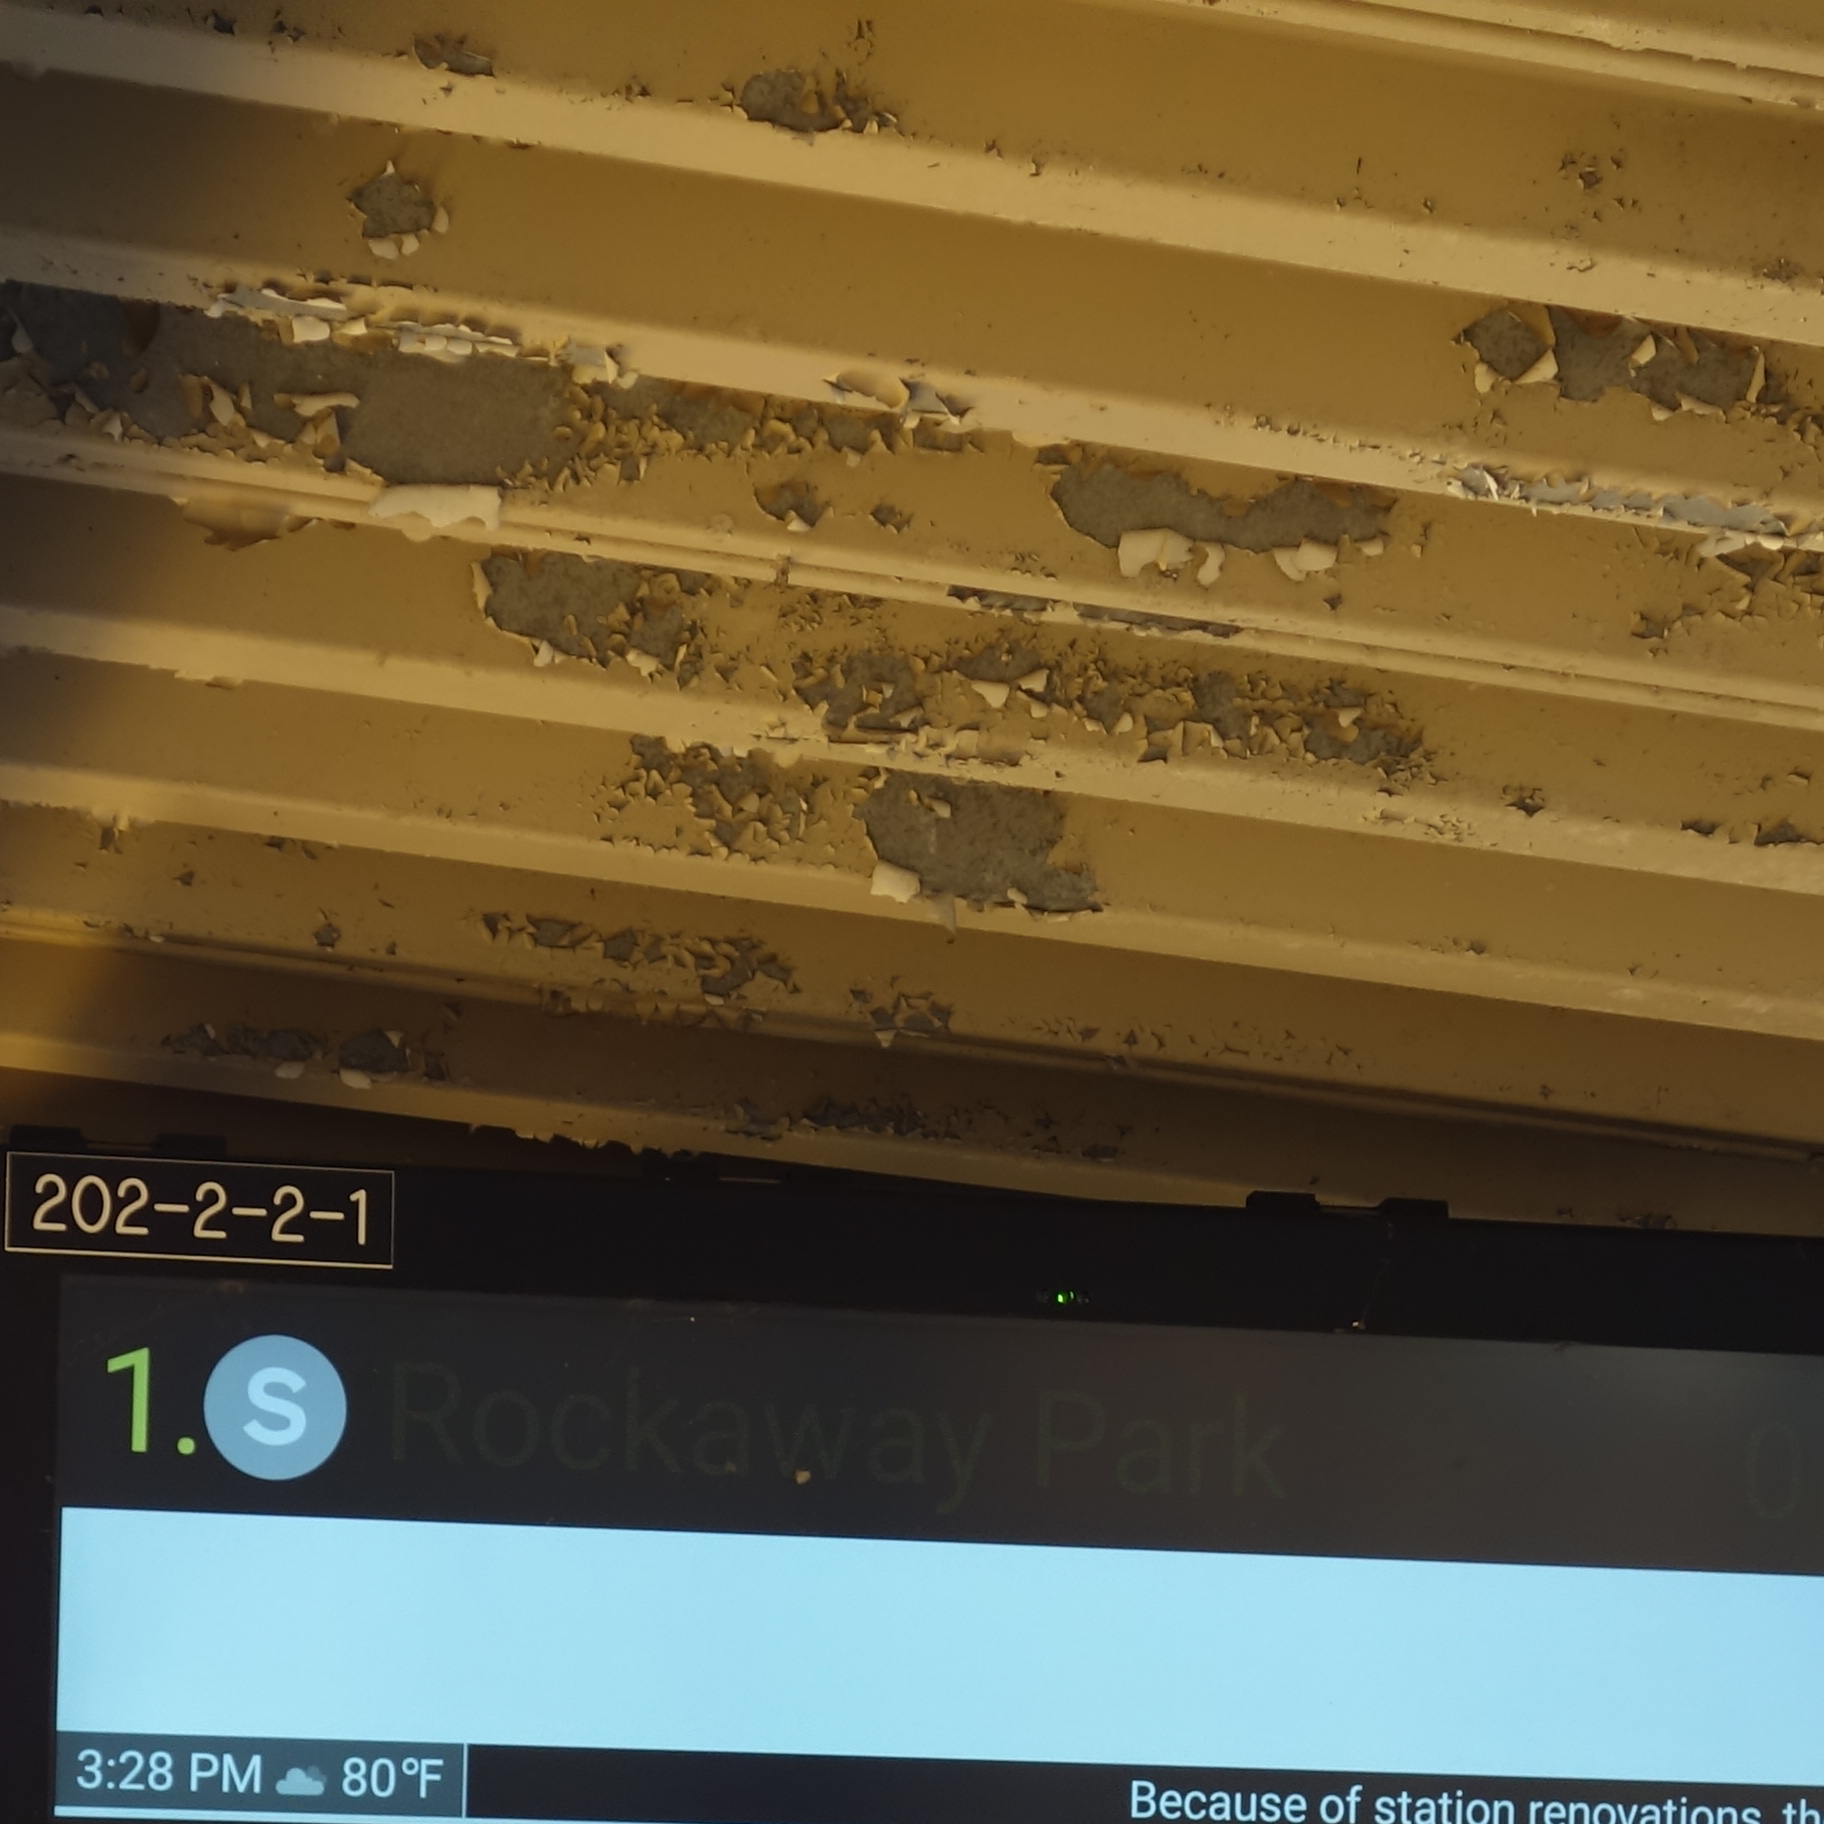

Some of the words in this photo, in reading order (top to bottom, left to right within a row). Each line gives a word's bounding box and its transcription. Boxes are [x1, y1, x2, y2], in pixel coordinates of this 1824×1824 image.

[32, 1173, 368, 1246] 202-2-2-1
[106, 1346, 197, 1456] 1.
[242, 1366, 307, 1447] S
[391, 1361, 990, 1515] Rockaway
[1036, 1389, 1291, 1499] Park
[76, 1748, 174, 1792] 3:28
[189, 1752, 262, 1795] PM
[341, 1756, 445, 1799] 80°F
[1130, 1779, 1308, 1824] Because
